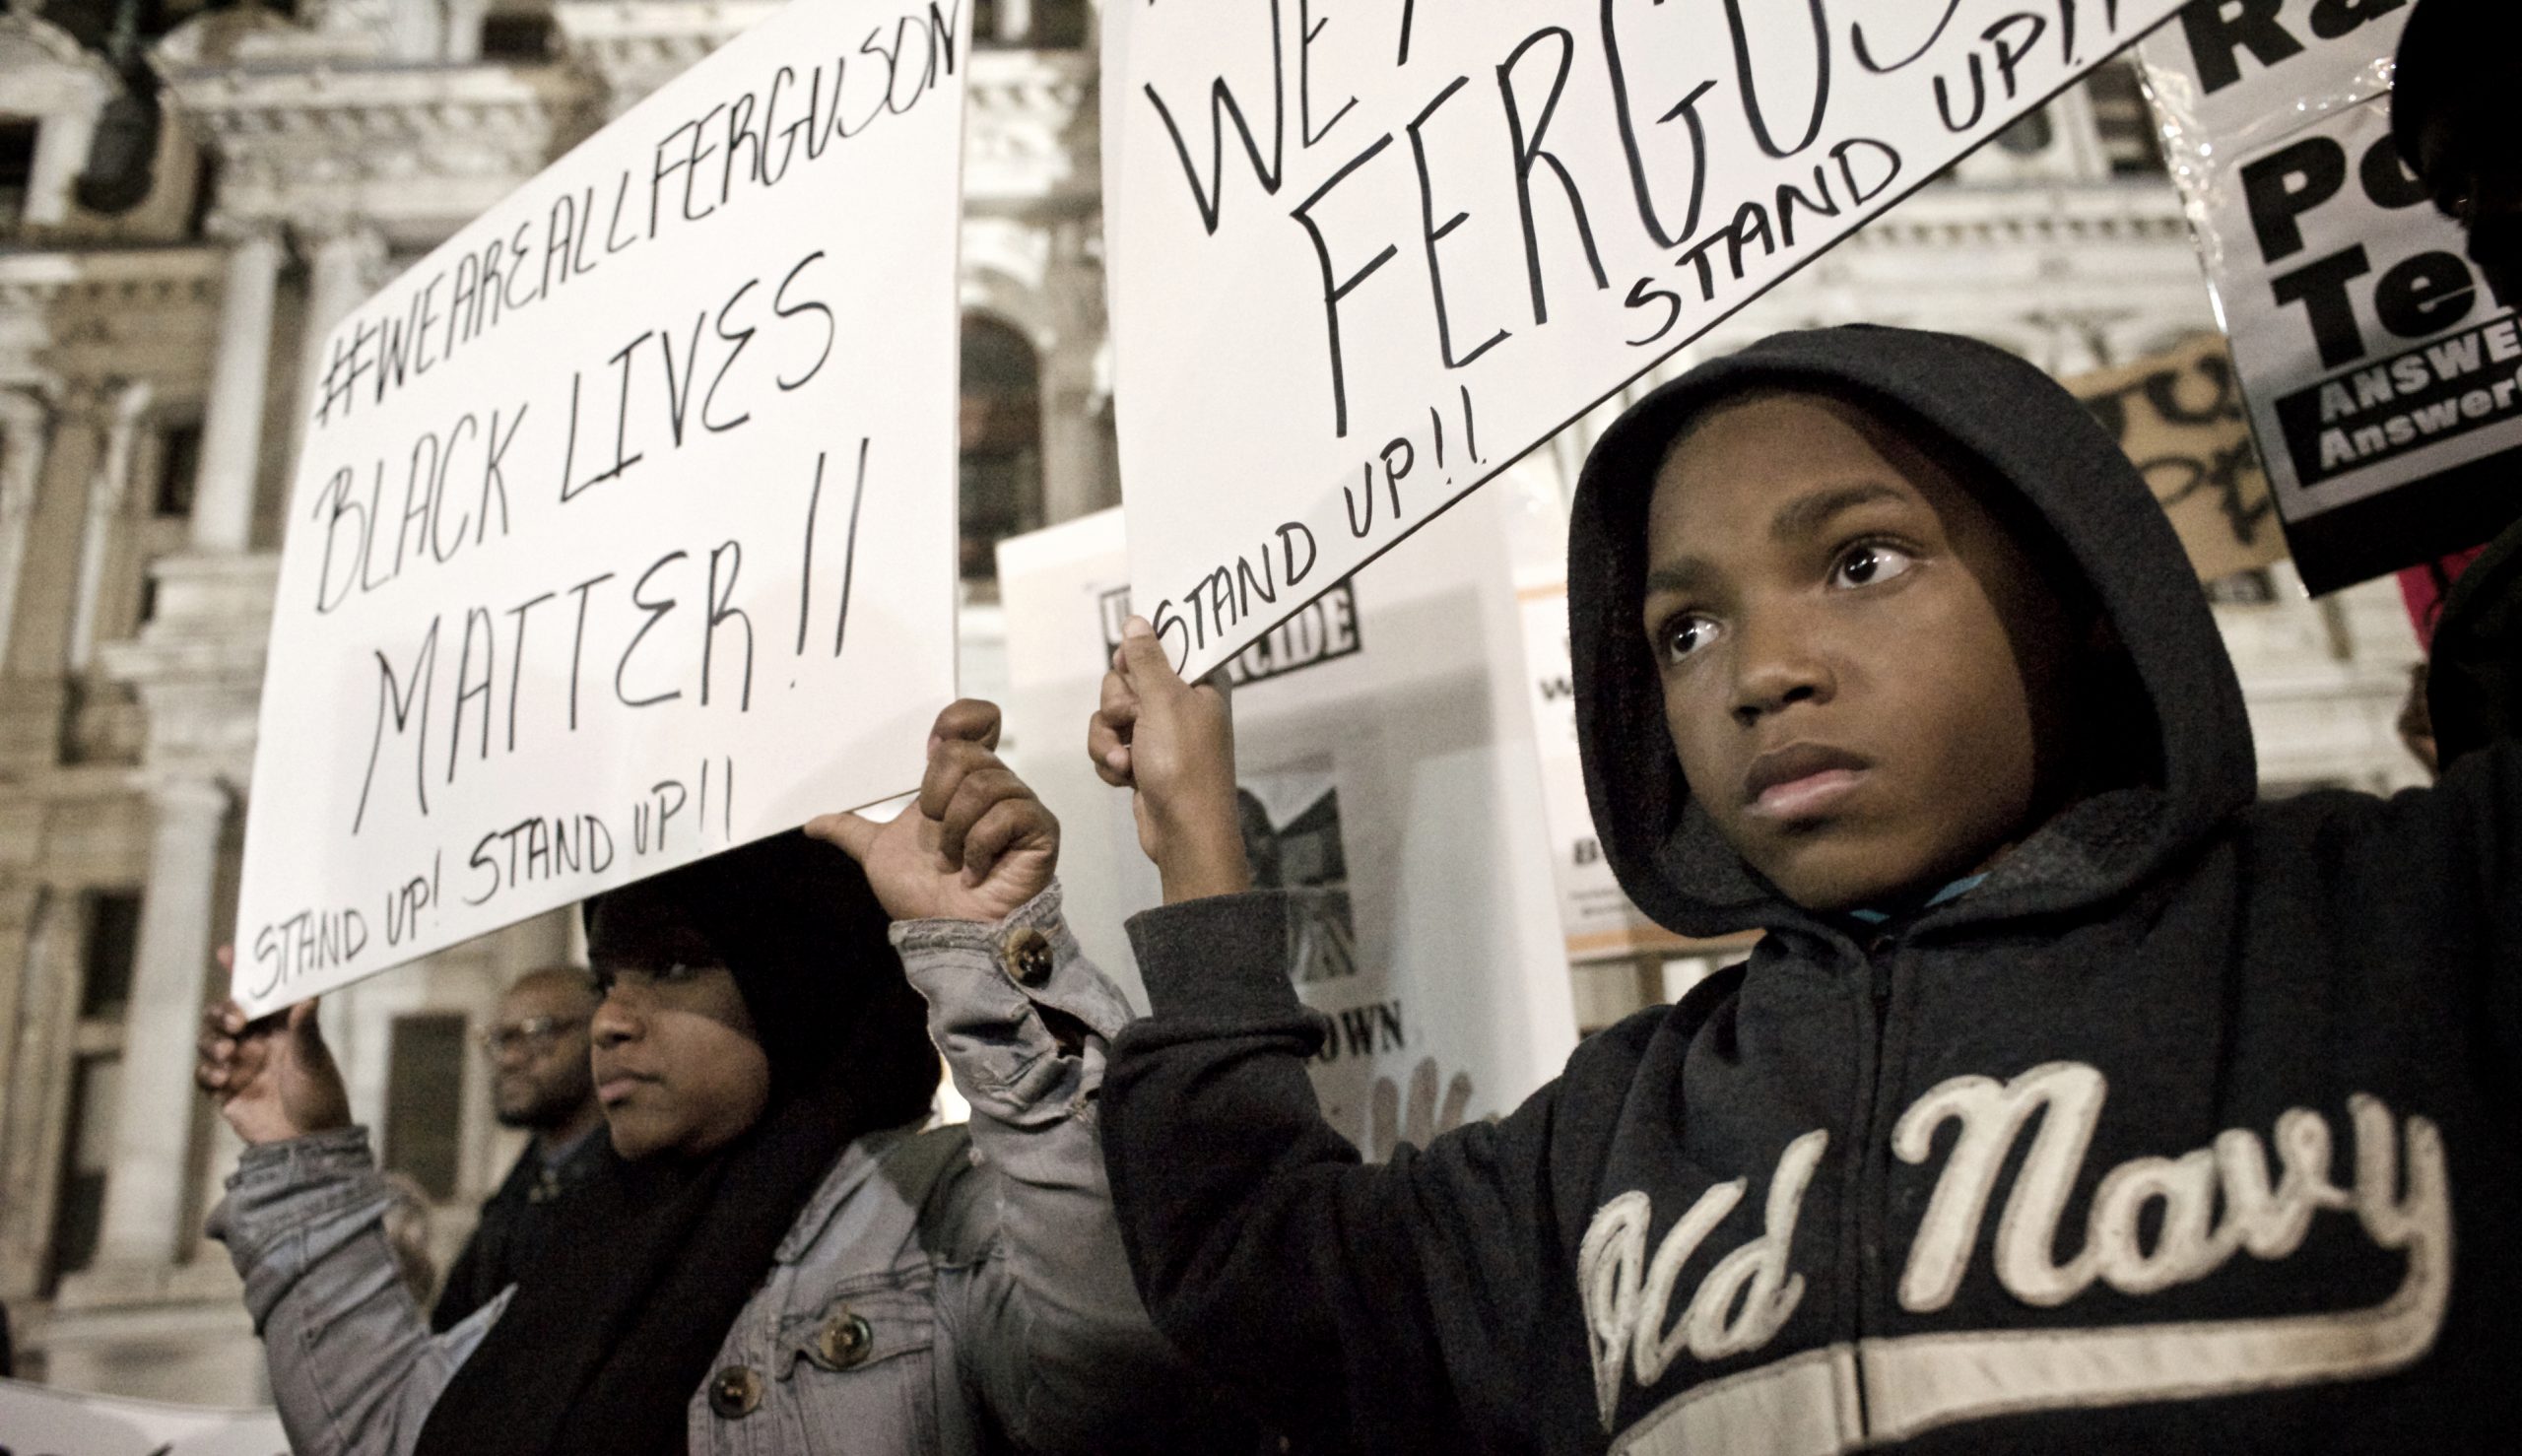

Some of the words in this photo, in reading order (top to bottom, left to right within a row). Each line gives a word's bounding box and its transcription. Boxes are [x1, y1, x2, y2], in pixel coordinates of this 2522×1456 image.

[1143, 0, 1360, 236] WE
[2240, 135, 2435, 264] Po
[1153, 520, 1317, 676] STAND
[1343, 384, 1488, 538] UP!!
[1625, 138, 1902, 346] STAND
[2270, 243, 2485, 371] Te
[2319, 318, 2522, 424] ANSWE
[2319, 369, 2522, 472] Answer
[313, 403, 529, 614] BLACK
[561, 250, 834, 503] LIVES
[352, 437, 869, 835] MATTER!!
[249, 908, 368, 999] STAND
[386, 848, 442, 947] UP!
[463, 814, 616, 907] STAND
[633, 755, 733, 855] UP!!
[1580, 1128, 1828, 1433] Old
[1892, 1060, 2453, 1322] Navy
